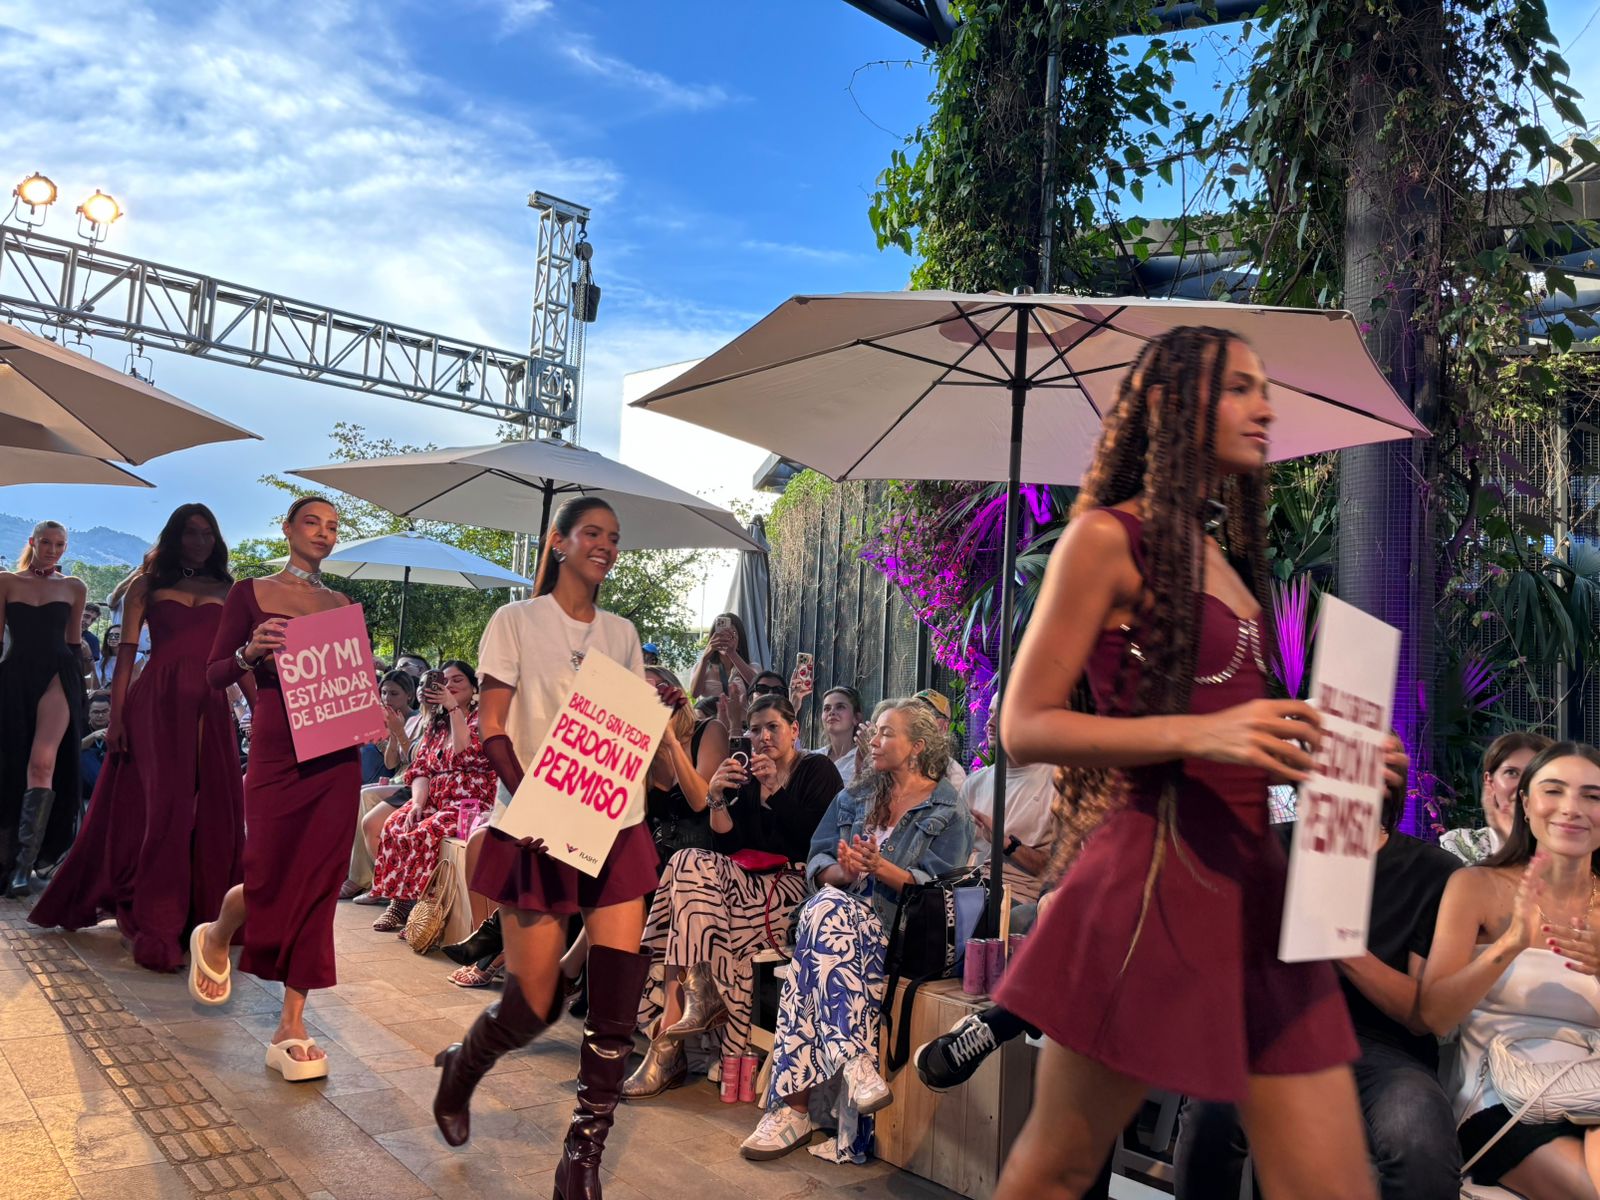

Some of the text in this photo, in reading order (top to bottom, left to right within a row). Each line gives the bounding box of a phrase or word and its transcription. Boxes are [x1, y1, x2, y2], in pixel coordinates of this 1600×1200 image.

[279, 637, 363, 684] SOY MI
[286, 670, 373, 709] ESTÁNDAR
[291, 690, 380, 730] DE BELLEZA
[568, 692, 651, 752] BRILLO SIN PEDIR
[552, 713, 643, 782] PERDÓN NI
[533, 745, 628, 820] PERMISO
[579, 851, 599, 865] FLASHY
[945, 889, 955, 928] DKNY
